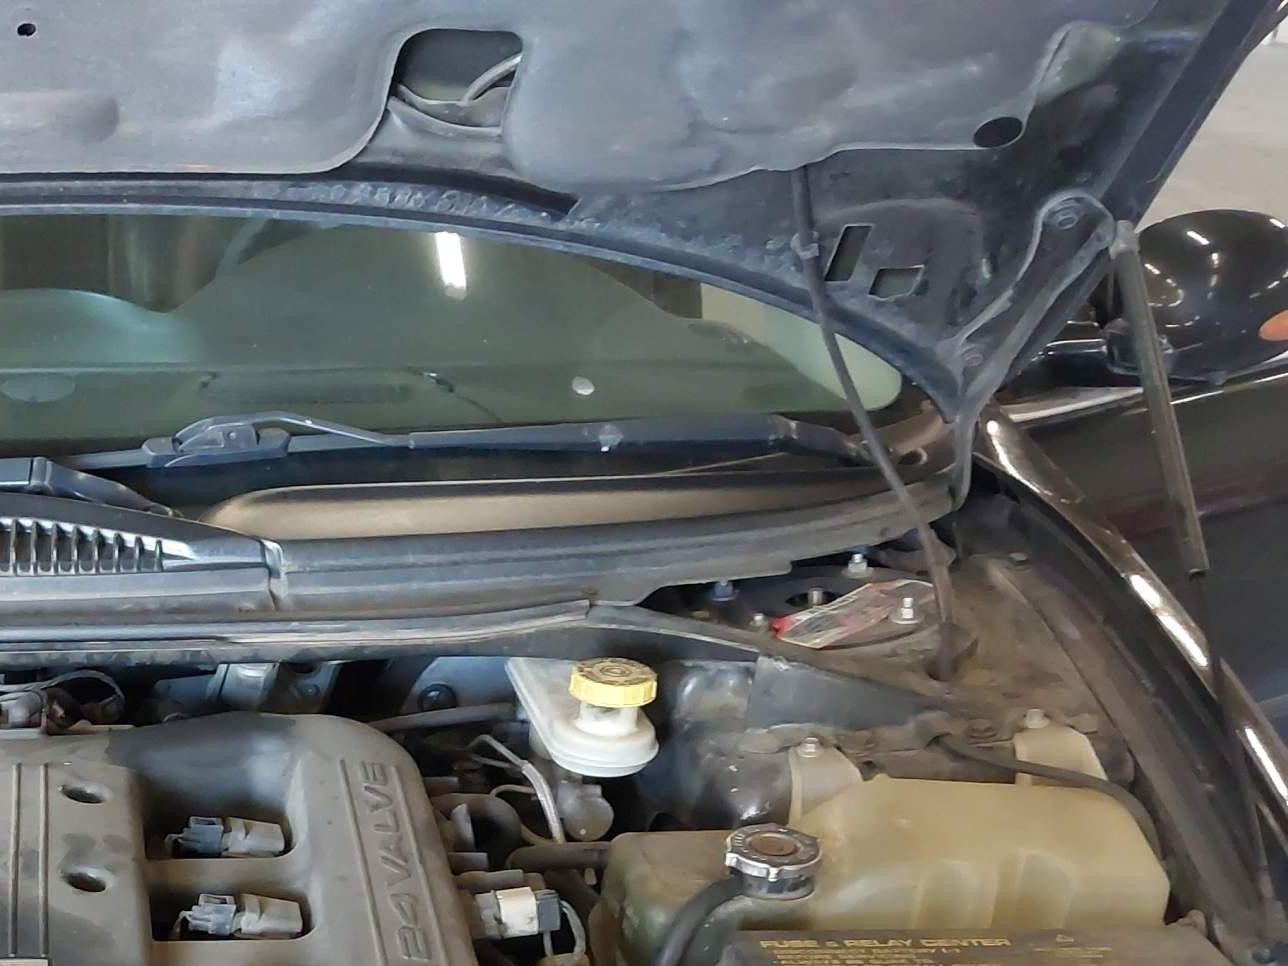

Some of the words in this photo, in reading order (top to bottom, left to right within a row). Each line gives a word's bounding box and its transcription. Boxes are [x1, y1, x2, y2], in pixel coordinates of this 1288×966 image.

[759, 940, 819, 949] FUSE
[843, 939, 912, 948] RELAY
[919, 938, 1012, 947] CENTER
